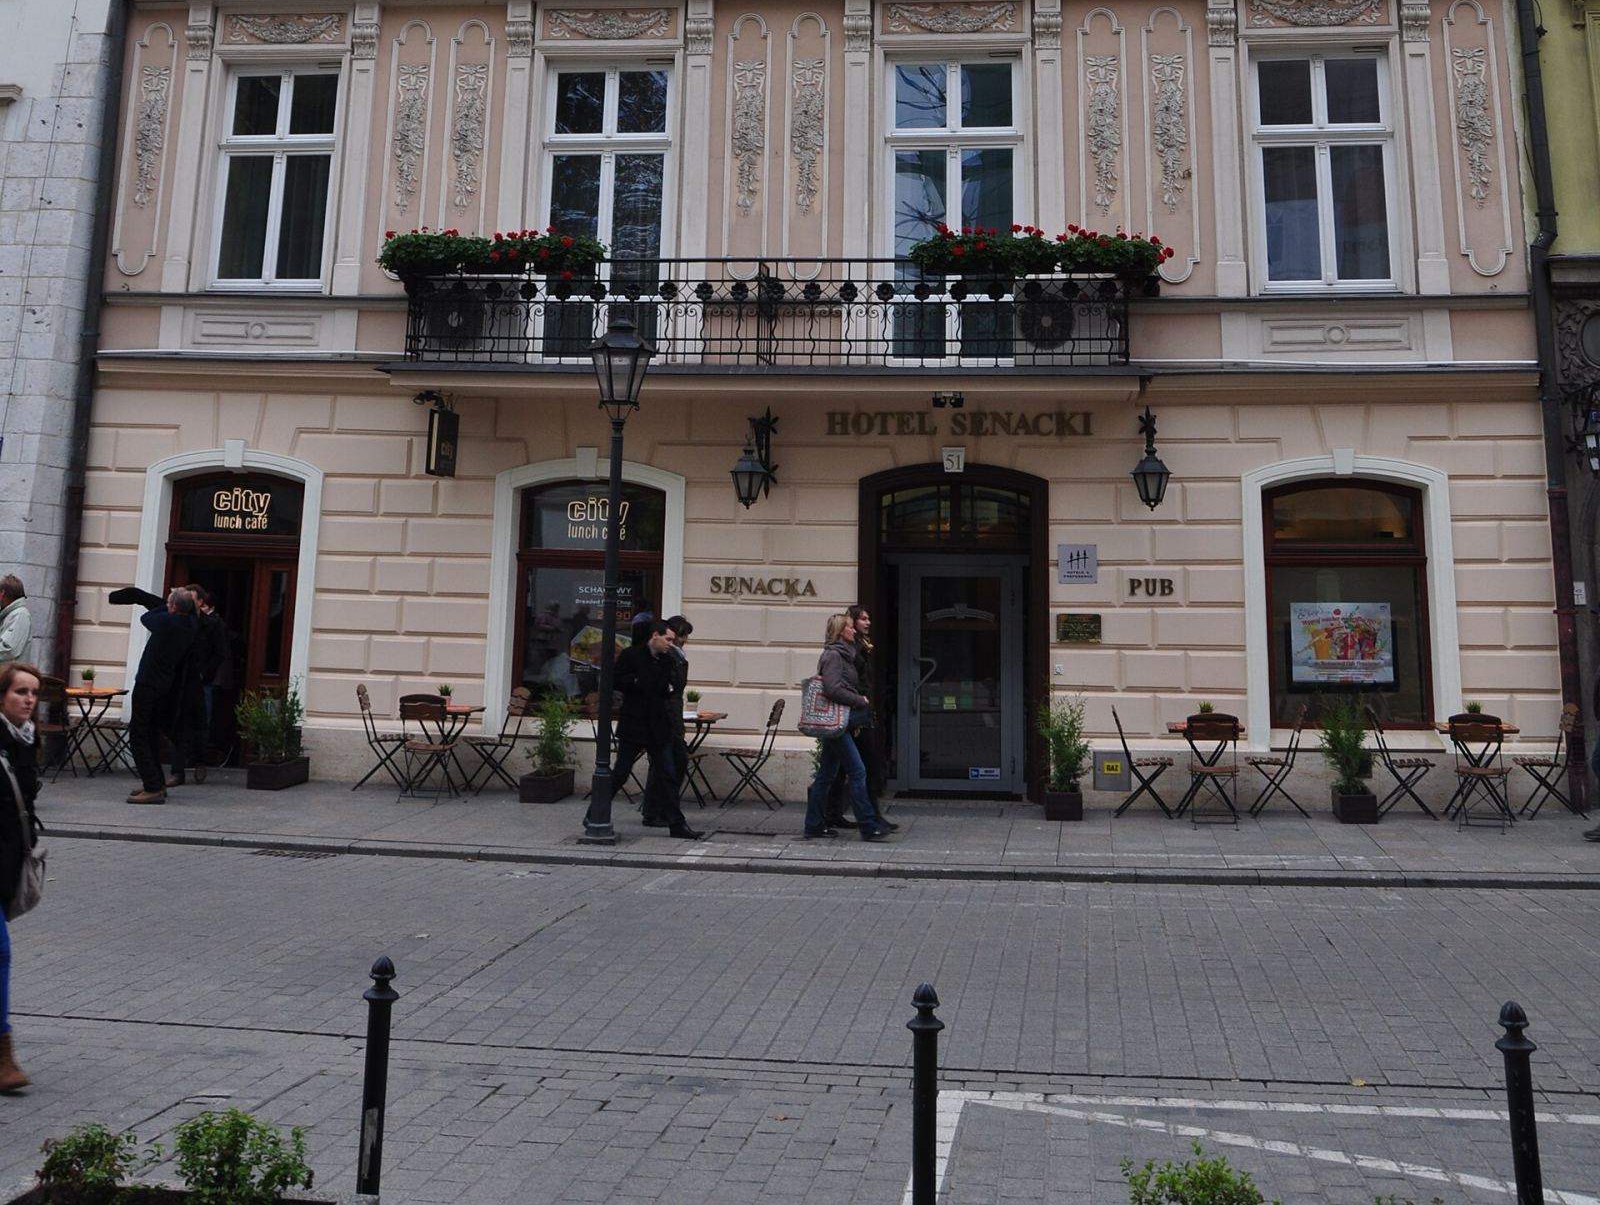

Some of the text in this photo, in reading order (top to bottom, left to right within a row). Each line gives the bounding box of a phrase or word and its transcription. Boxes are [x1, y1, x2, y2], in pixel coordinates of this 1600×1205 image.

[825, 411, 1095, 436] HOTEL SENACKI
[945, 453, 963, 471] 51
[213, 487, 271, 516] city
[214, 513, 268, 530] lunch café
[568, 523, 626, 541] lunch cé
[710, 576, 818, 597] SENACKA
[1128, 578, 1174, 597] PUB
[1106, 764, 1119, 772] GAZ
